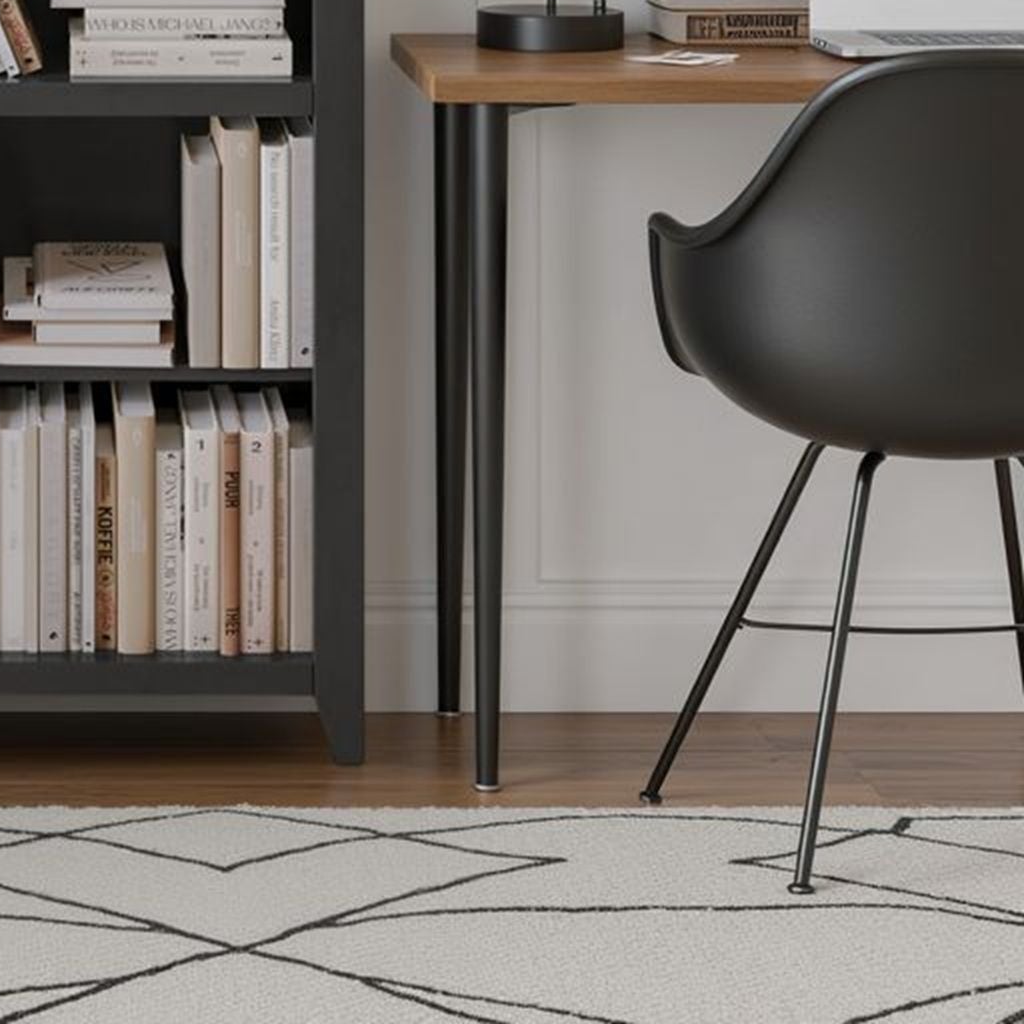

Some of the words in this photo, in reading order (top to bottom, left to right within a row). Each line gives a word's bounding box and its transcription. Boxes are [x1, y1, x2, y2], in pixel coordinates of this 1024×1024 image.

[87, 17, 129, 31] WHO
[131, 17, 145, 31] IS
[146, 17, 215, 31] MICHAEL
[252, 441, 262, 453] 2
[225, 471, 239, 508] PUUR
[98, 507, 113, 564] KOFFIE
[225, 607, 239, 636] THEE
